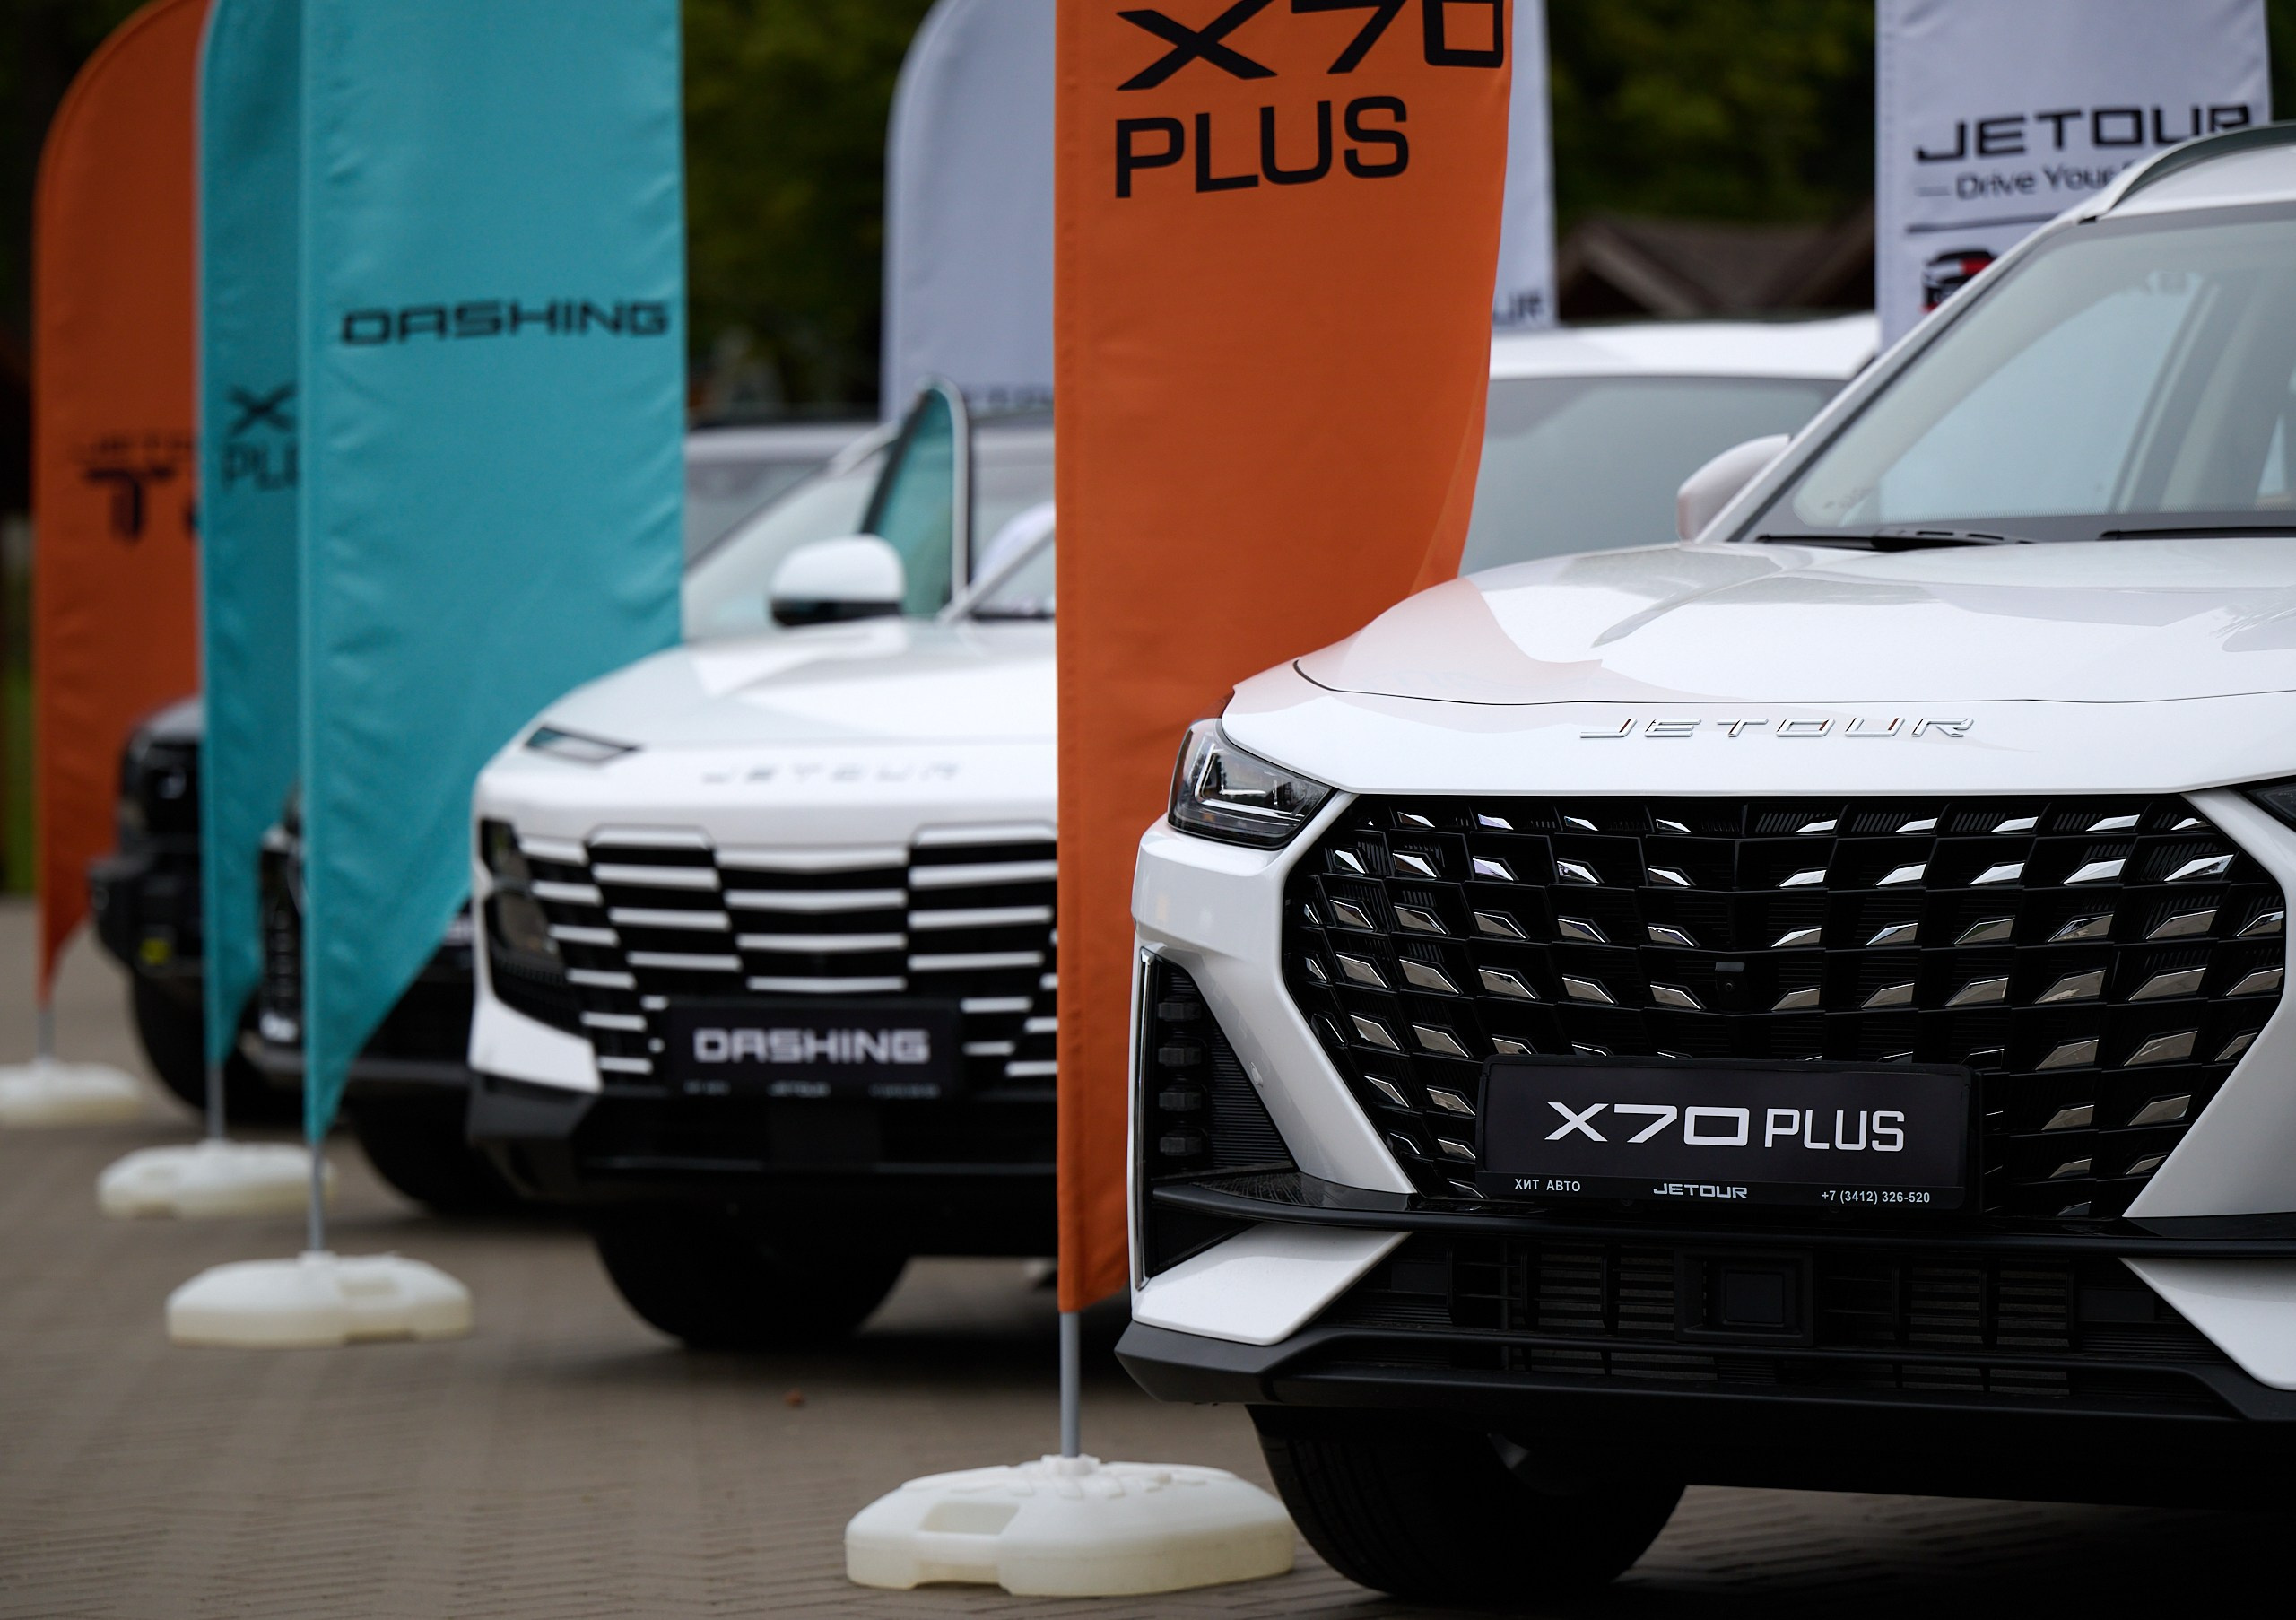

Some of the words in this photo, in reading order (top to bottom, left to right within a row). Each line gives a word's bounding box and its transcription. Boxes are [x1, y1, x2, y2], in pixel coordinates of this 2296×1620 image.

[1115, 0, 1504, 91] X70
[1115, 95, 1409, 198] PLUS
[1914, 104, 2251, 162] JETOUR
[1956, 170, 2035, 200] Drive
[341, 300, 671, 345] DASHING
[1579, 718, 1975, 738] JETOUR
[693, 1029, 931, 1064] DASHING
[1544, 1102, 1750, 1147] X70
[1764, 1108, 1905, 1152] PLUS
[1514, 1178, 1540, 1191] ХИТ
[1545, 1180, 1581, 1192] АВТО
[1653, 1182, 1748, 1199] JETOUR
[1822, 1190, 1836, 1201] +7
[1839, 1190, 1878, 1205] (3412)
[1882, 1191, 1930, 1203] 326-520
